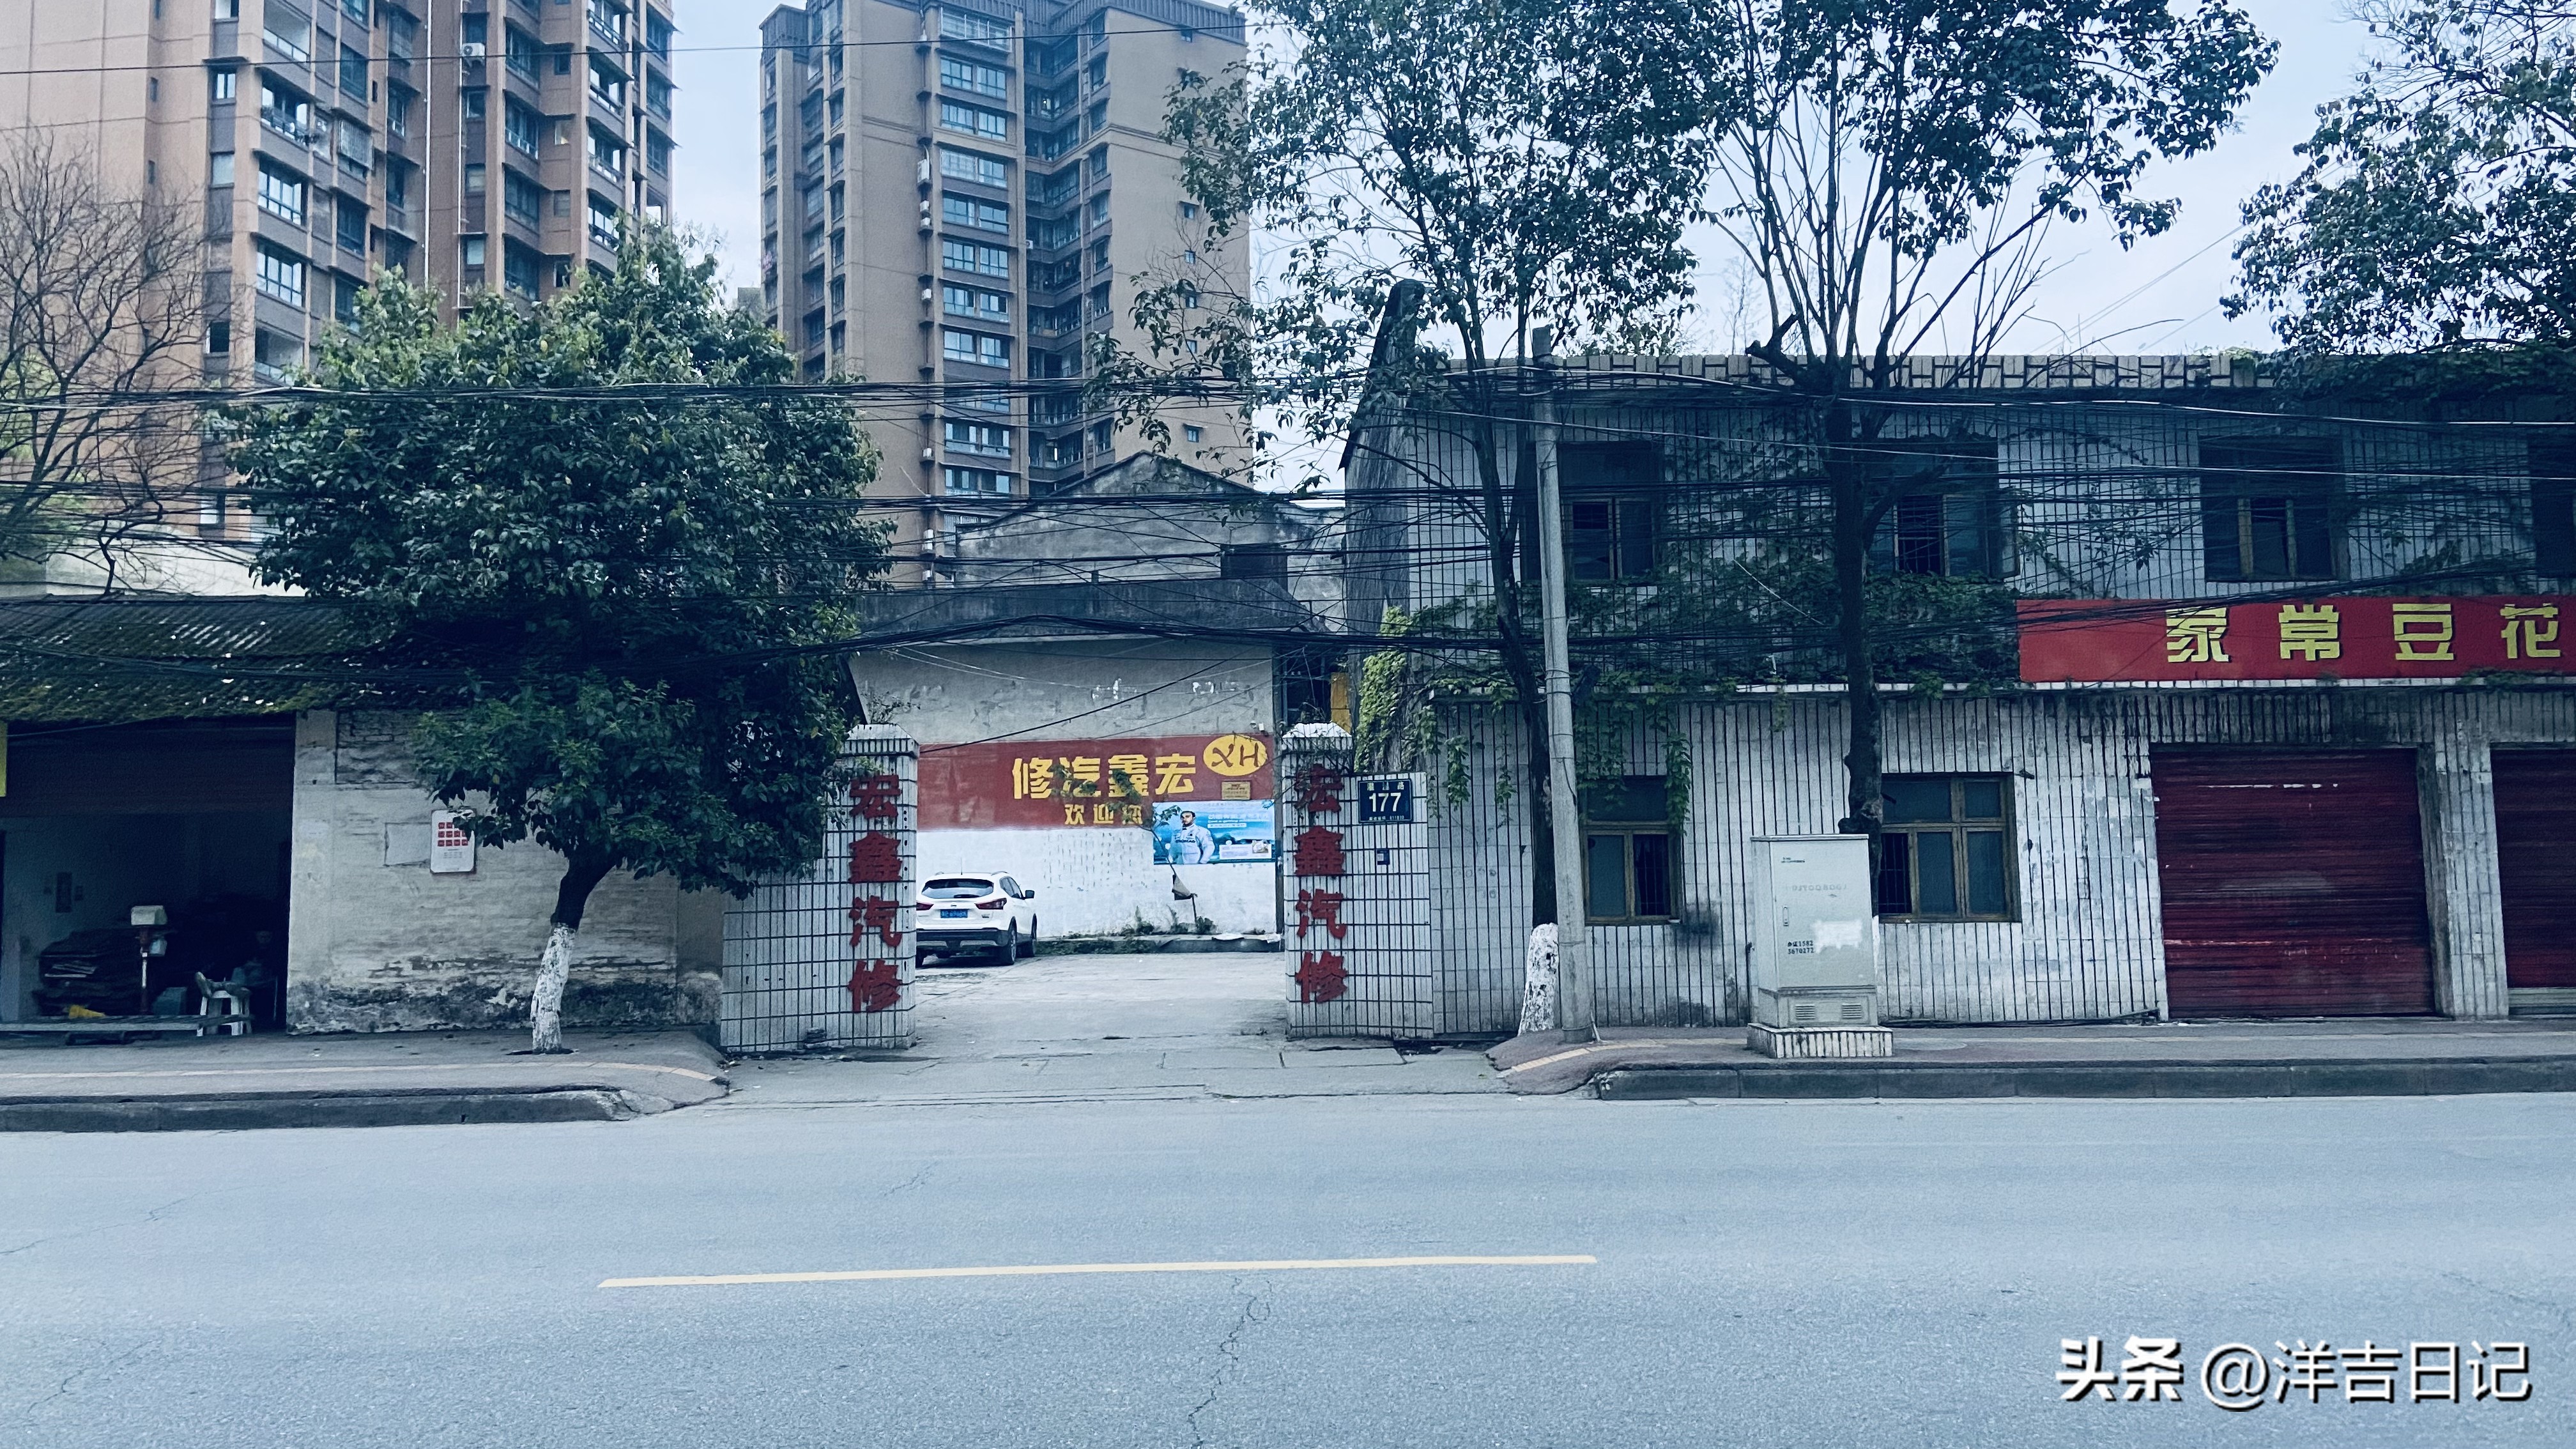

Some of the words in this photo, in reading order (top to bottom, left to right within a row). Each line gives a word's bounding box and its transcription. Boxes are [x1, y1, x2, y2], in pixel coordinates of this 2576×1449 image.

[2166, 603, 2561, 662] 家常豆花
[1211, 742, 1259, 768] XH
[1065, 804, 1143, 824] 欢迎您
[1369, 792, 1401, 812] 177
[849, 772, 901, 1013] 宏鑫汽修
[1294, 763, 1347, 1004] 宏鑫汽修
